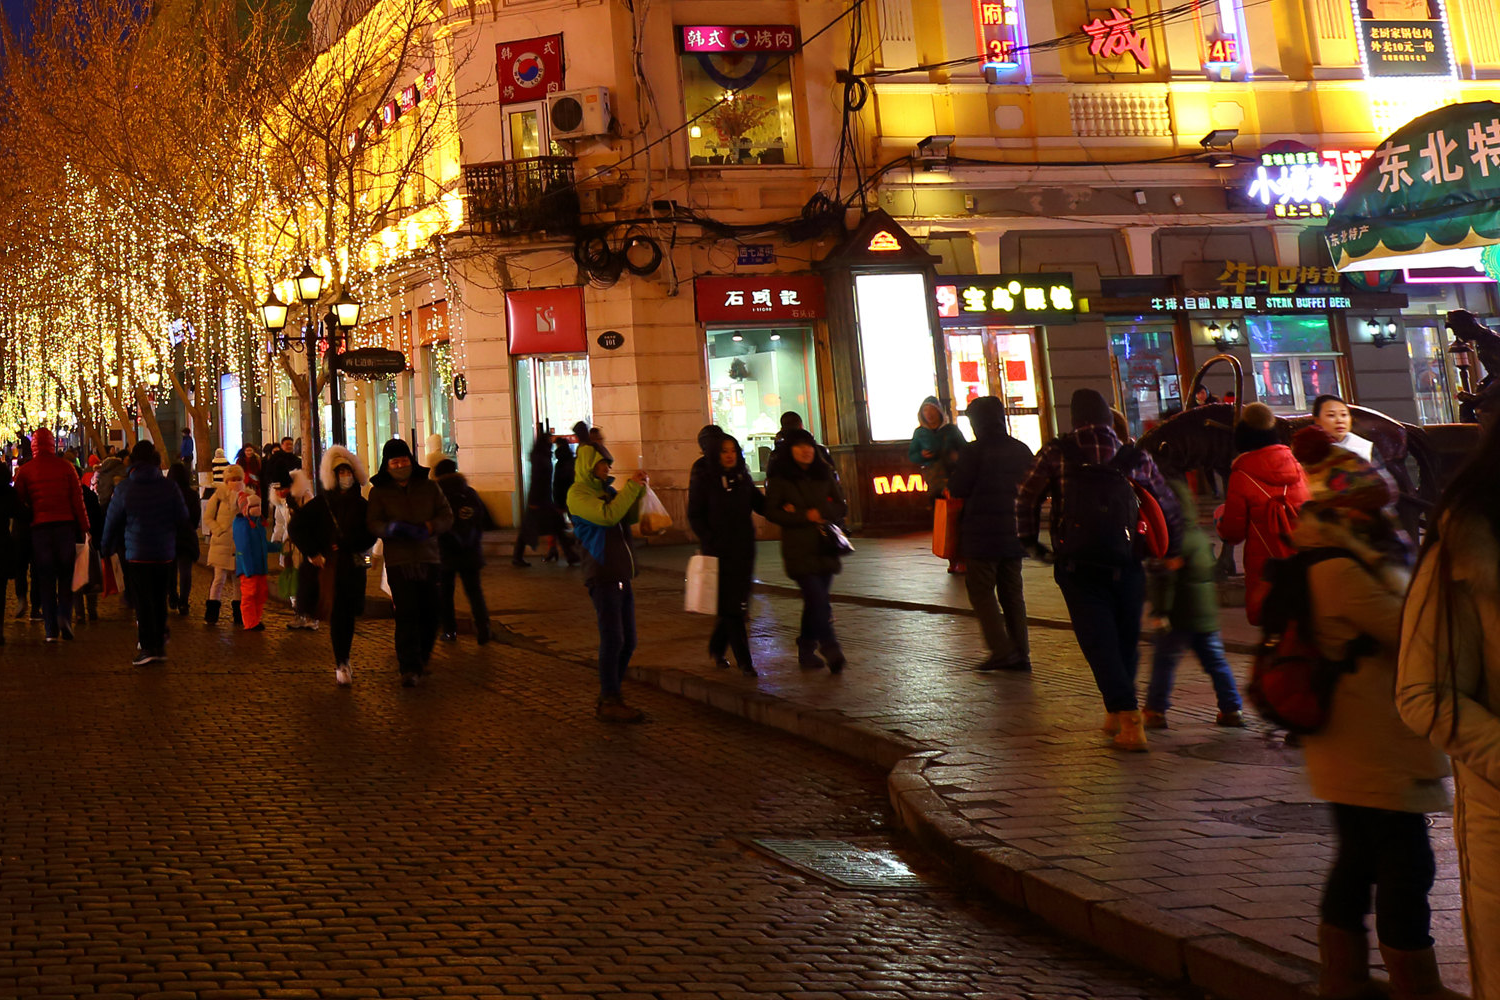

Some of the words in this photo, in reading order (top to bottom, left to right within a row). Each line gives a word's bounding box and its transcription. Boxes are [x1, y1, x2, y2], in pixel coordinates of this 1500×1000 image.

[687, 29, 725, 48] 韩式
[754, 30, 793, 48] 烤肉
[1370, 27, 1433, 39] 老厨家锅包肉
[1212, 40, 1237, 63] 4F
[1370, 41, 1435, 53] 外卖10元一份
[1329, 225, 1370, 247] 东北特产
[1296, 297, 1326, 309] BUFFET
[1329, 297, 1351, 308] BEER
